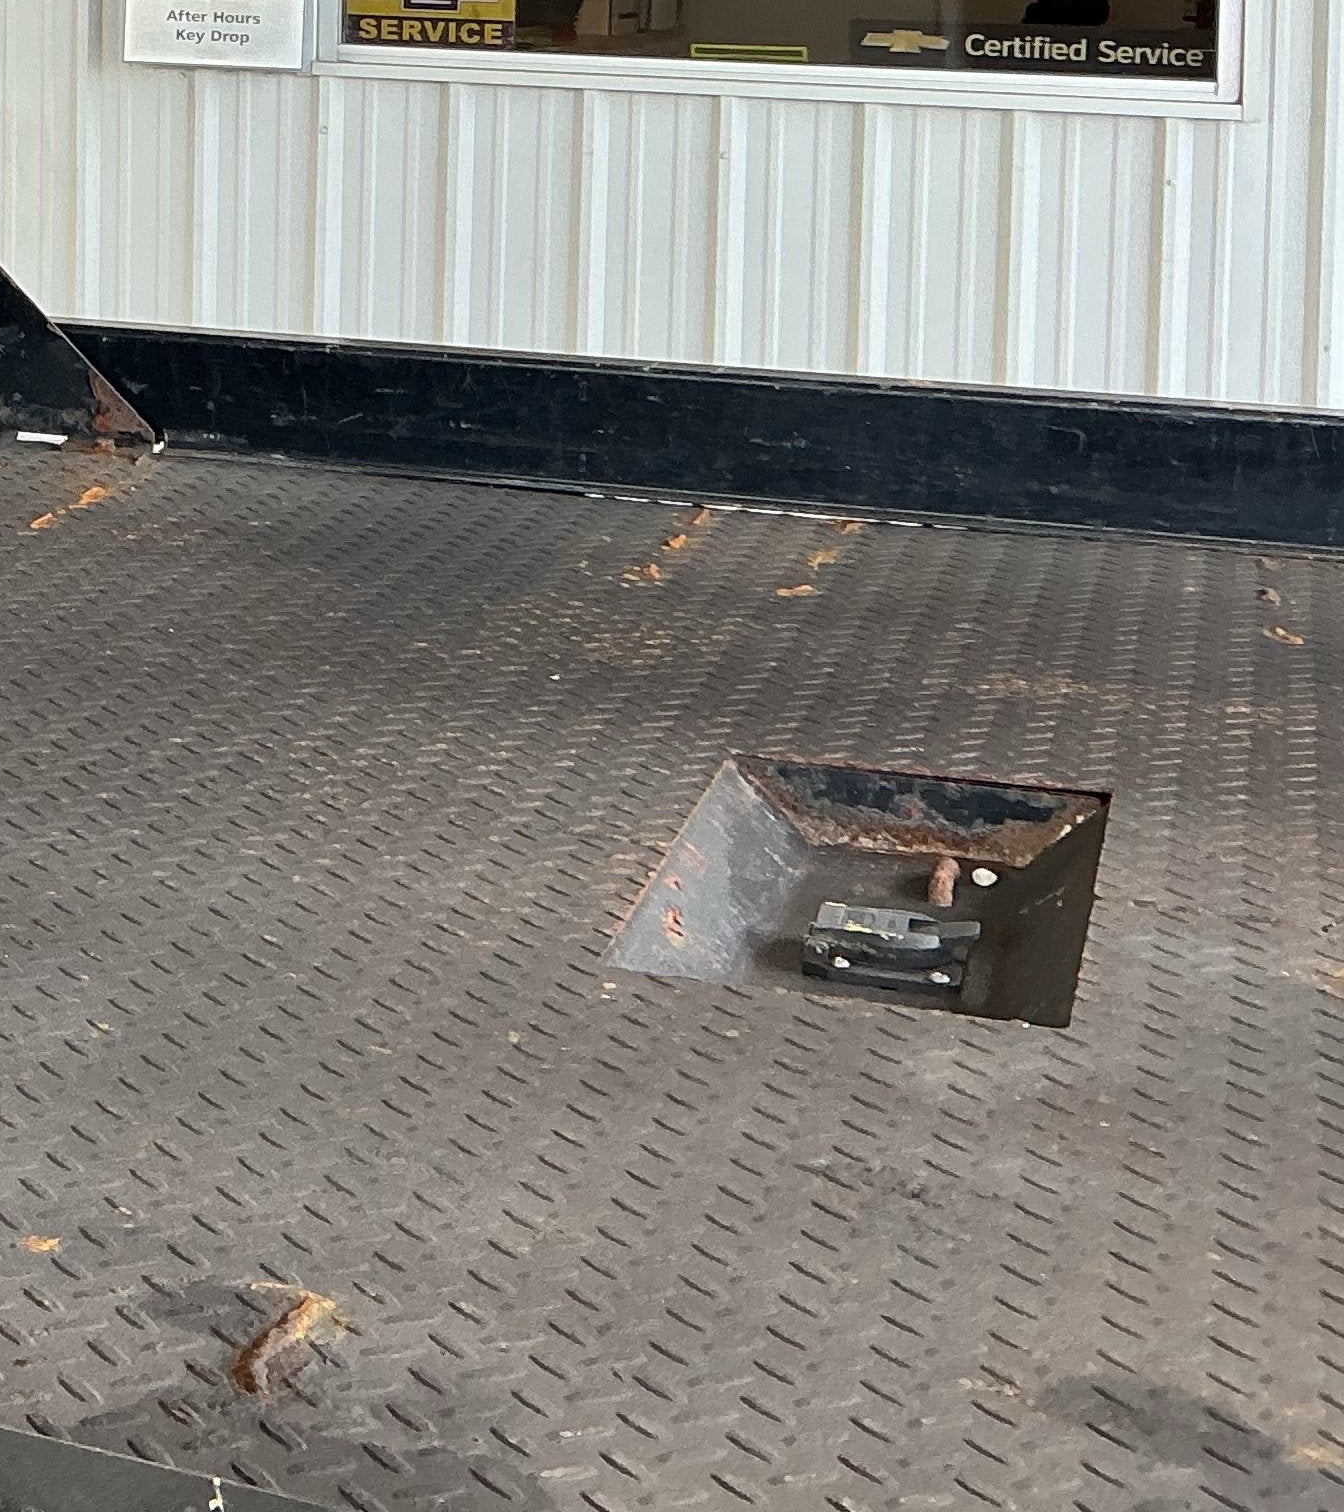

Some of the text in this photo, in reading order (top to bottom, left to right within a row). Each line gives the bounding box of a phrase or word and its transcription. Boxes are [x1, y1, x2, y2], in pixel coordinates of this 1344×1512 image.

[166, 9, 261, 25] After Hours
[175, 28, 250, 46] Key Drop
[358, 17, 503, 45] SERVICE
[964, 33, 1204, 68] Certified Service
